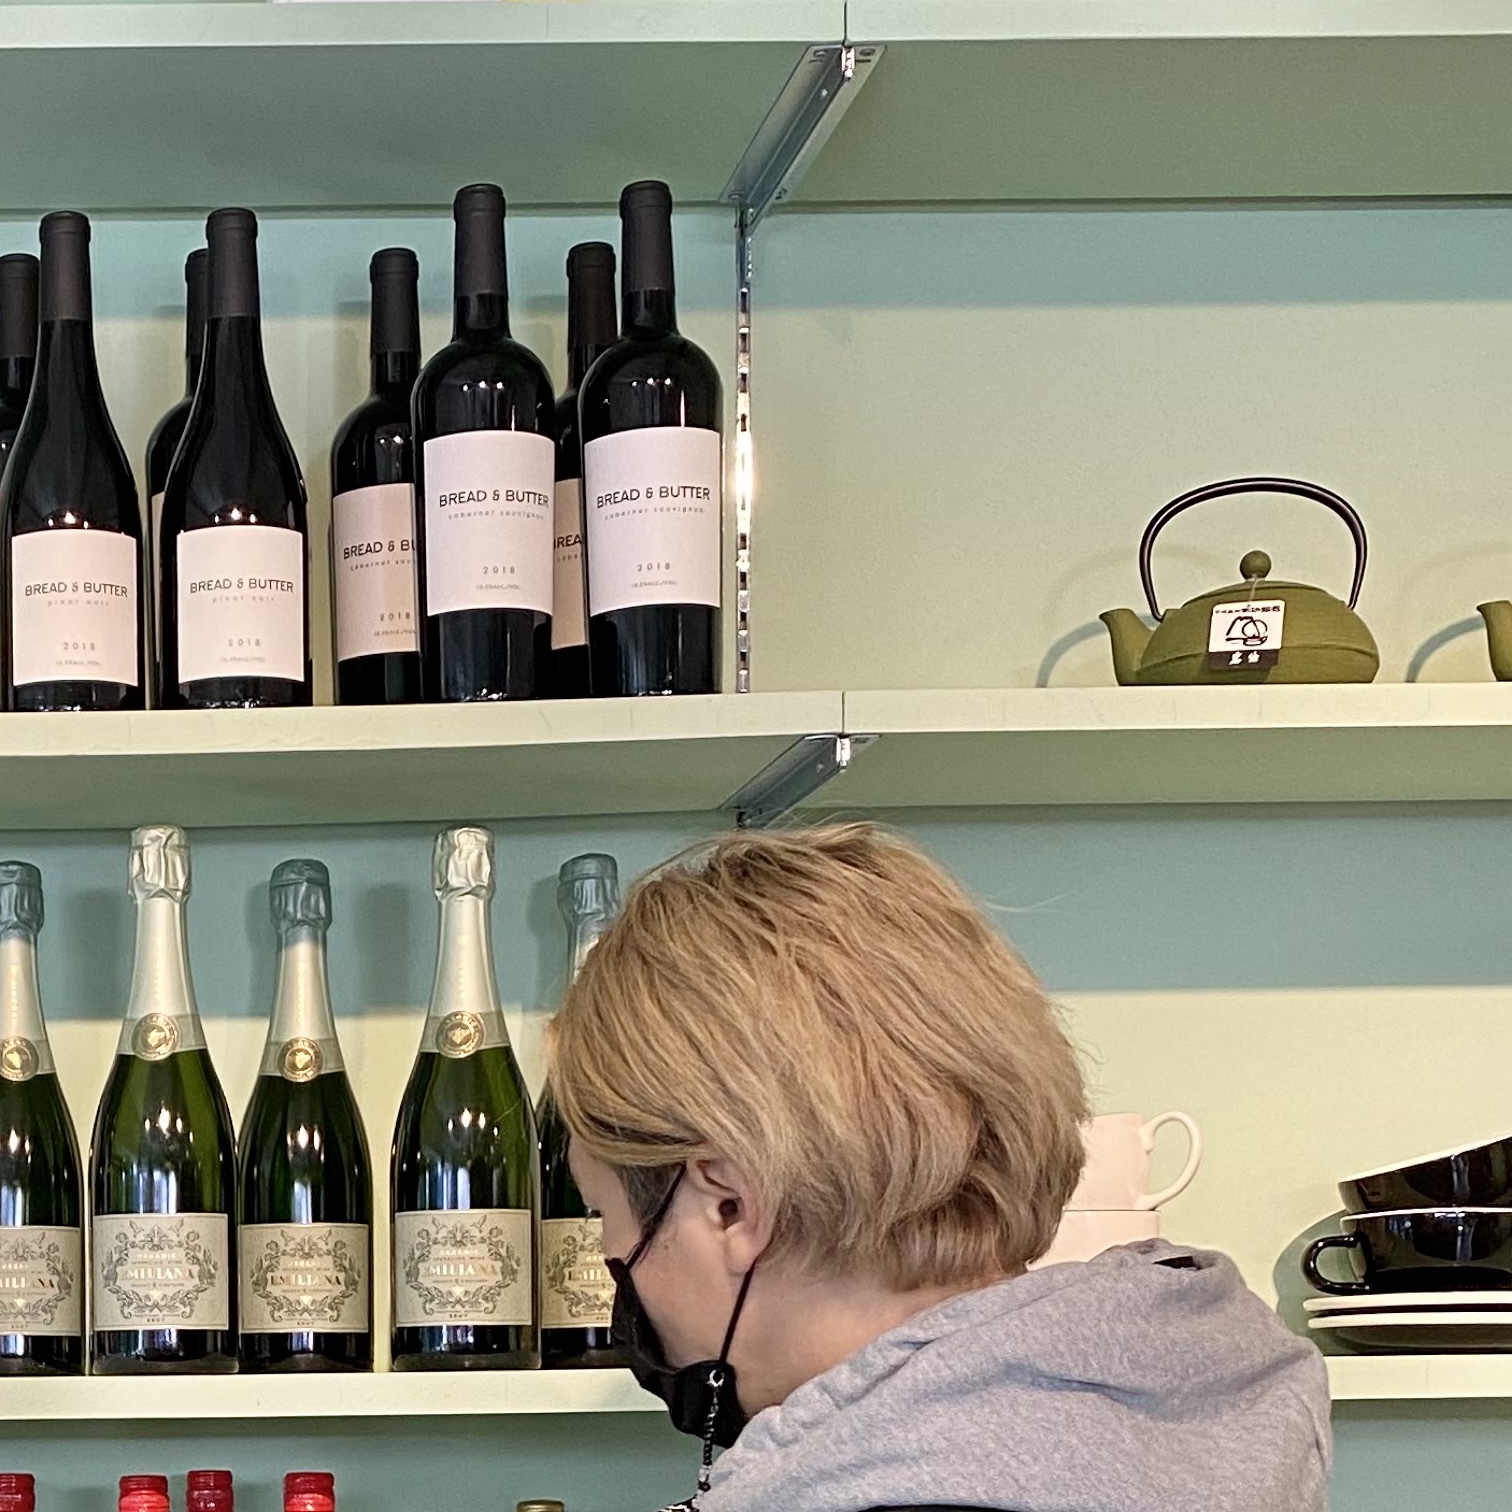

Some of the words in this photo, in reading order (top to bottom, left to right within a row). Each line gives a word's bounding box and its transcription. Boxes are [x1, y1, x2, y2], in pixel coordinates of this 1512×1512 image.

[439, 489, 487, 507] BREAD
[492, 489, 500, 501] &
[506, 489, 550, 507] BUTTER
[597, 488, 640, 509] BREAD
[645, 487, 653, 499] &
[659, 485, 710, 500] BUTTER
[343, 542, 383, 560] BREAD
[387, 540, 395, 552] &
[483, 565, 516, 575] 2018
[637, 562, 671, 572] 2018
[25, 582, 67, 597] BREAD
[72, 581, 78, 593] &
[83, 582, 128, 597] BUTTER
[190, 579, 232, 594] BREAD
[237, 578, 244, 589] &
[248, 578, 294, 593] BUTTER
[379, 612, 411, 621] 2018
[63, 642, 96, 651] 2018
[227, 638, 261, 647] 2018
